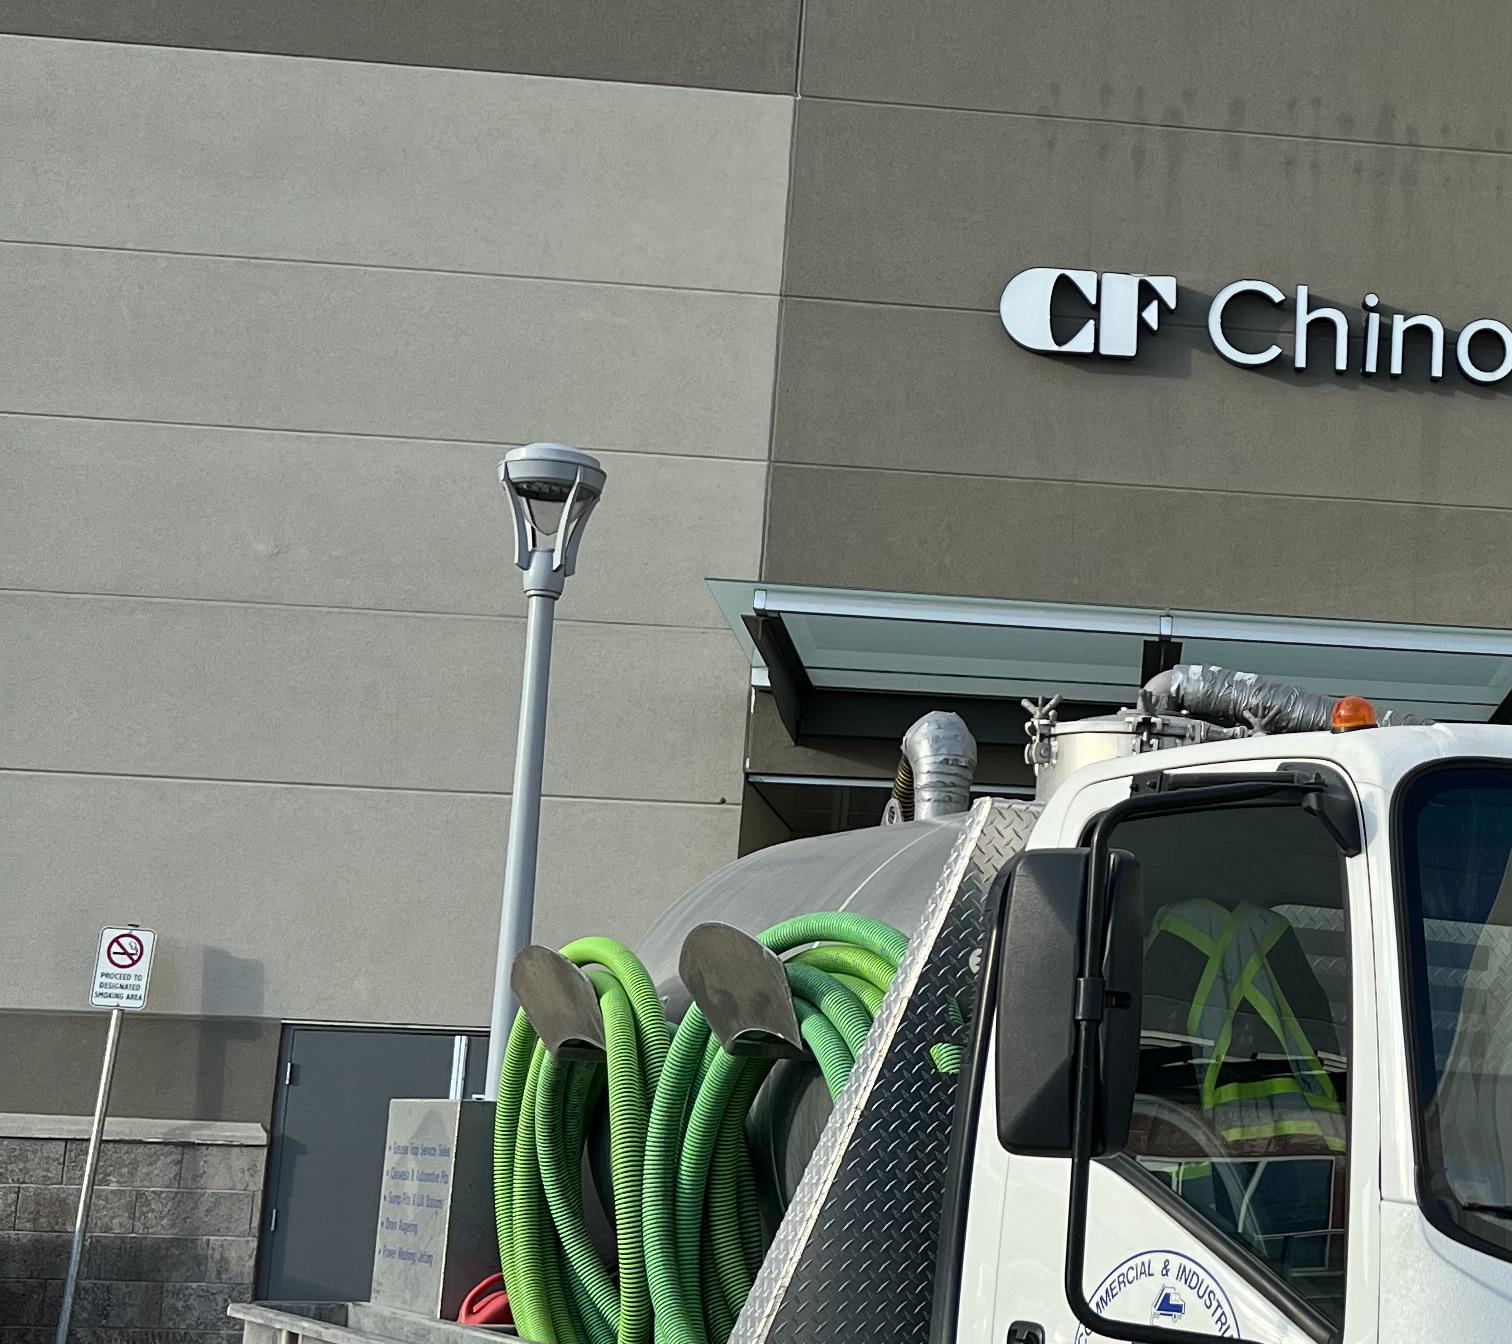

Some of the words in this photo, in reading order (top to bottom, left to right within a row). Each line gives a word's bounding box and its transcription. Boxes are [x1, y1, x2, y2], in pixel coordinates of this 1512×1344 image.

[999, 266, 1177, 360] CF
[100, 971, 131, 981] PROCEED
[133, 973, 143, 982] TO
[99, 981, 141, 991] DESIGNATED
[94, 991, 124, 1000] SMOKING
[125, 993, 142, 1001] AREA
[1161, 1259, 1170, 1277] &
